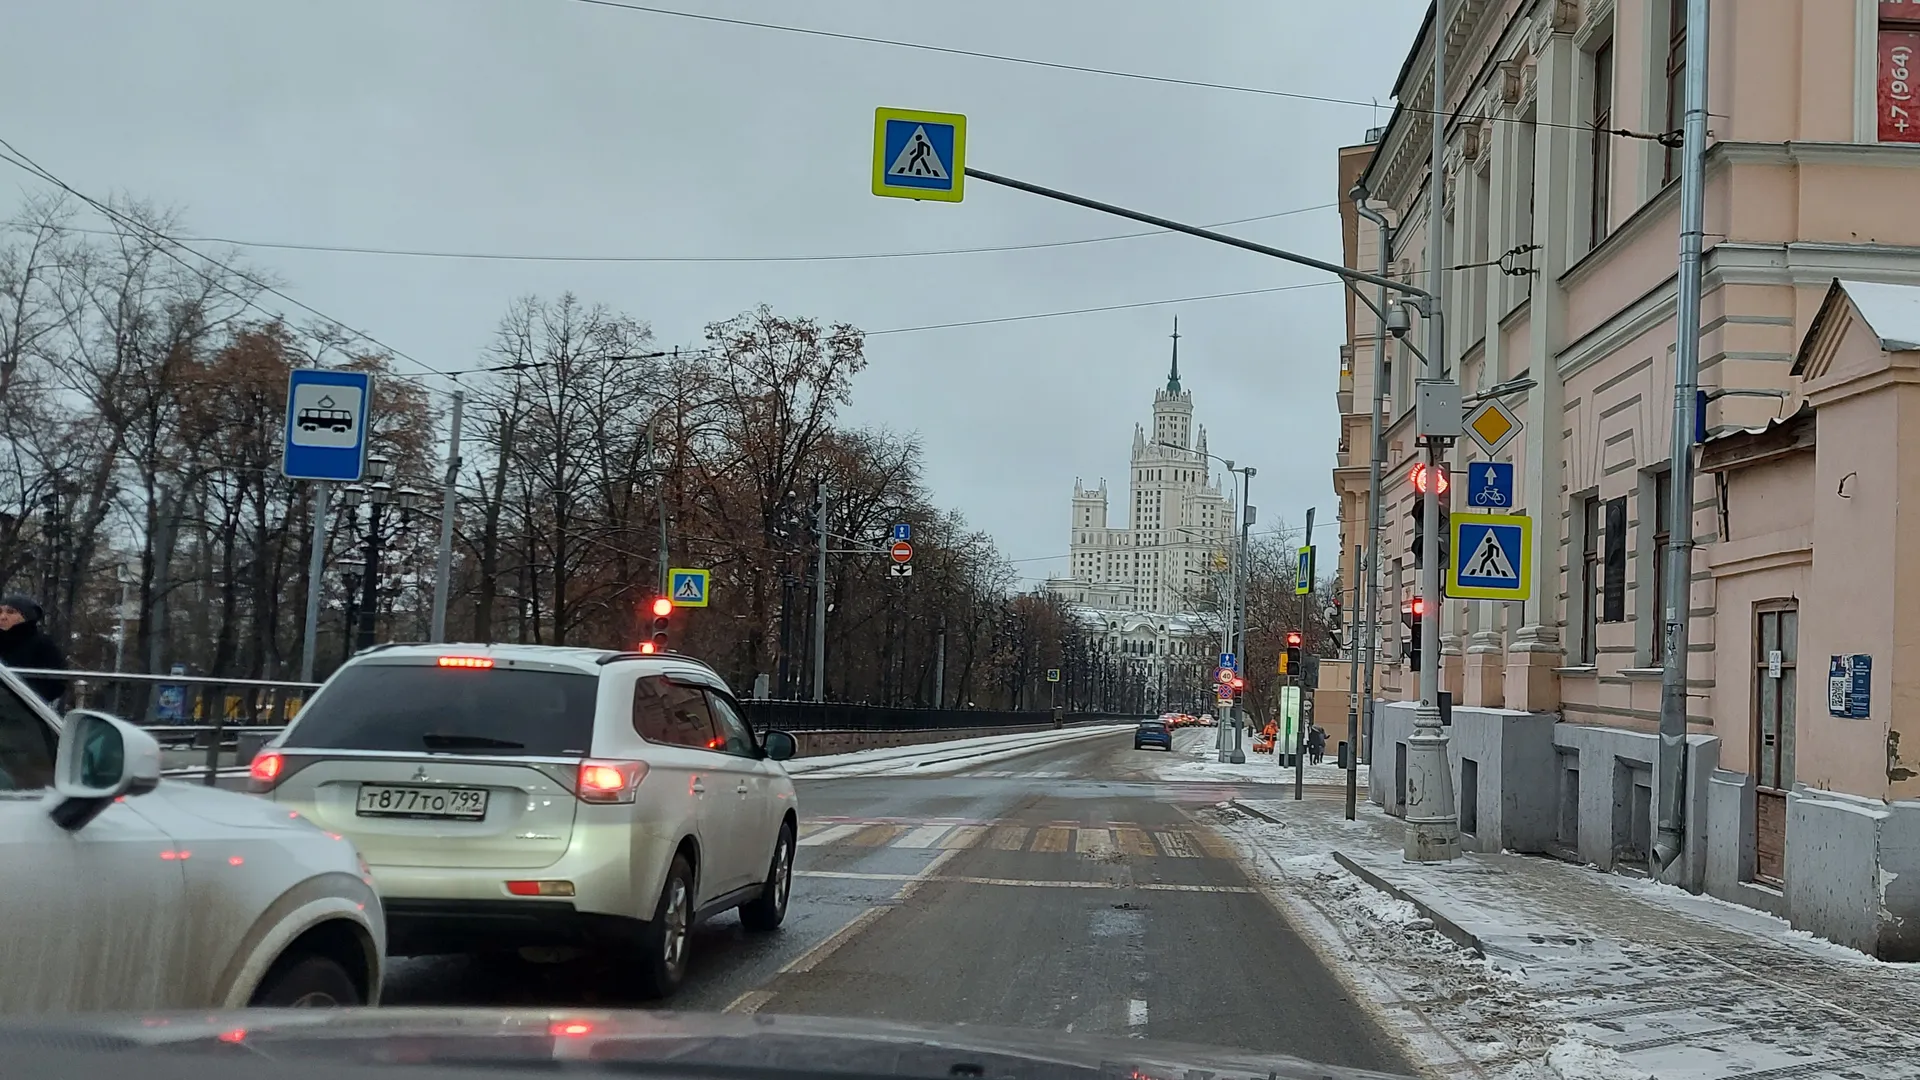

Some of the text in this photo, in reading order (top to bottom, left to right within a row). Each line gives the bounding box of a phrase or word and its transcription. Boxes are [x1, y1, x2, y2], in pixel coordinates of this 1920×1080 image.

[1890, 46, 1913, 133] +7 (964)
[450, 791, 480, 807] 799
